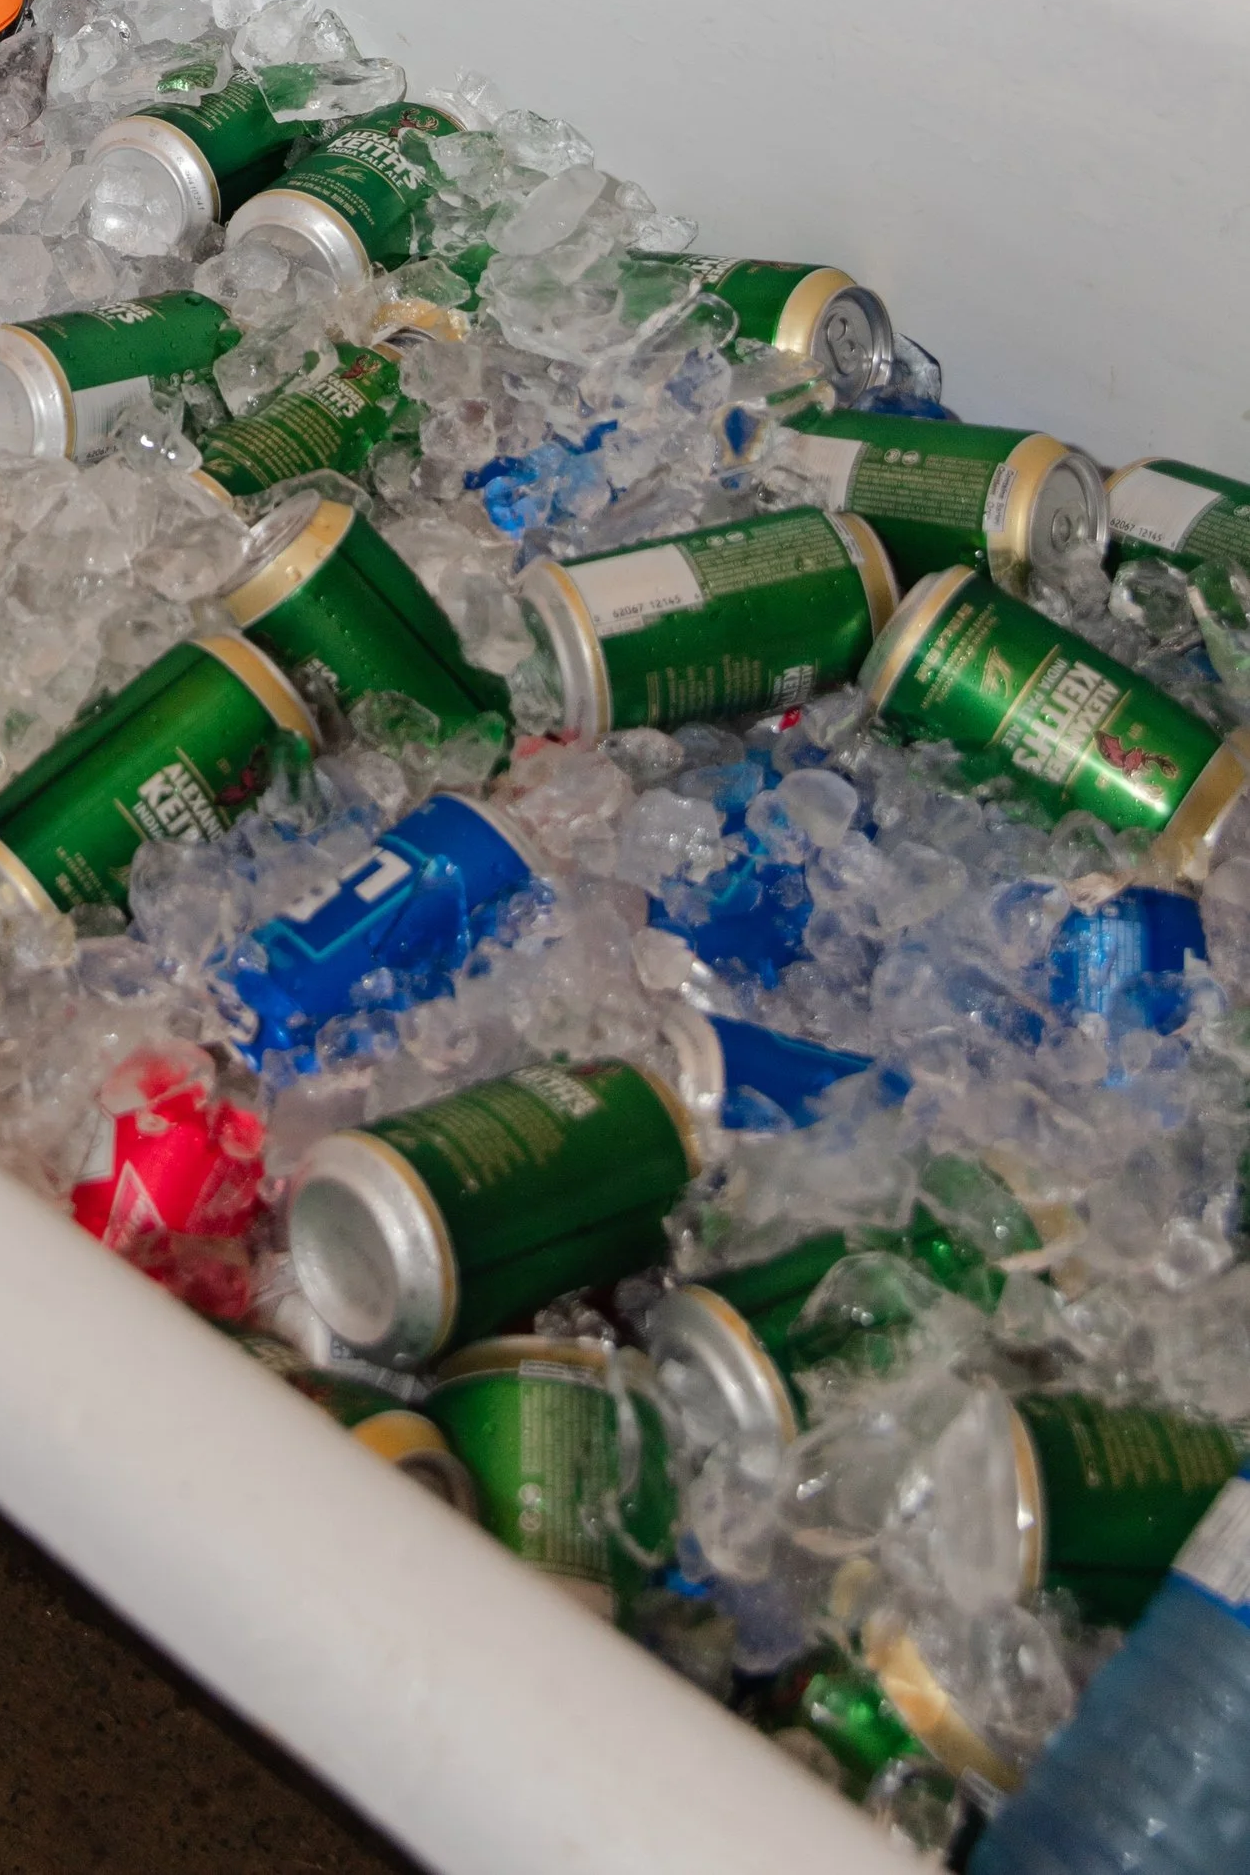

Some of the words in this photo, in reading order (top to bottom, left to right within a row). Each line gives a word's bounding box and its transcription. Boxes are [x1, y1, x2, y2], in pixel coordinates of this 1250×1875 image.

[344, 131, 400, 153] ALEXAN
[327, 137, 427, 190] KEITH'S
[360, 152, 386, 171] PALE
[385, 168, 404, 188] ALE
[316, 382, 361, 419] ITH'S
[327, 375, 366, 412] XANDER
[1110, 517, 1135, 532] 62067
[1138, 527, 1163, 542] 12145
[612, 603, 644, 619] 62067
[650, 594, 682, 609] 12145
[1038, 656, 1068, 692] INDIA
[1012, 660, 1102, 775] KEITH'S
[1018, 691, 1045, 722] PALE
[1000, 722, 1024, 749] ALE
[1043, 679, 1120, 784] ALEXANDER
[162, 762, 224, 843] ALEXAND
